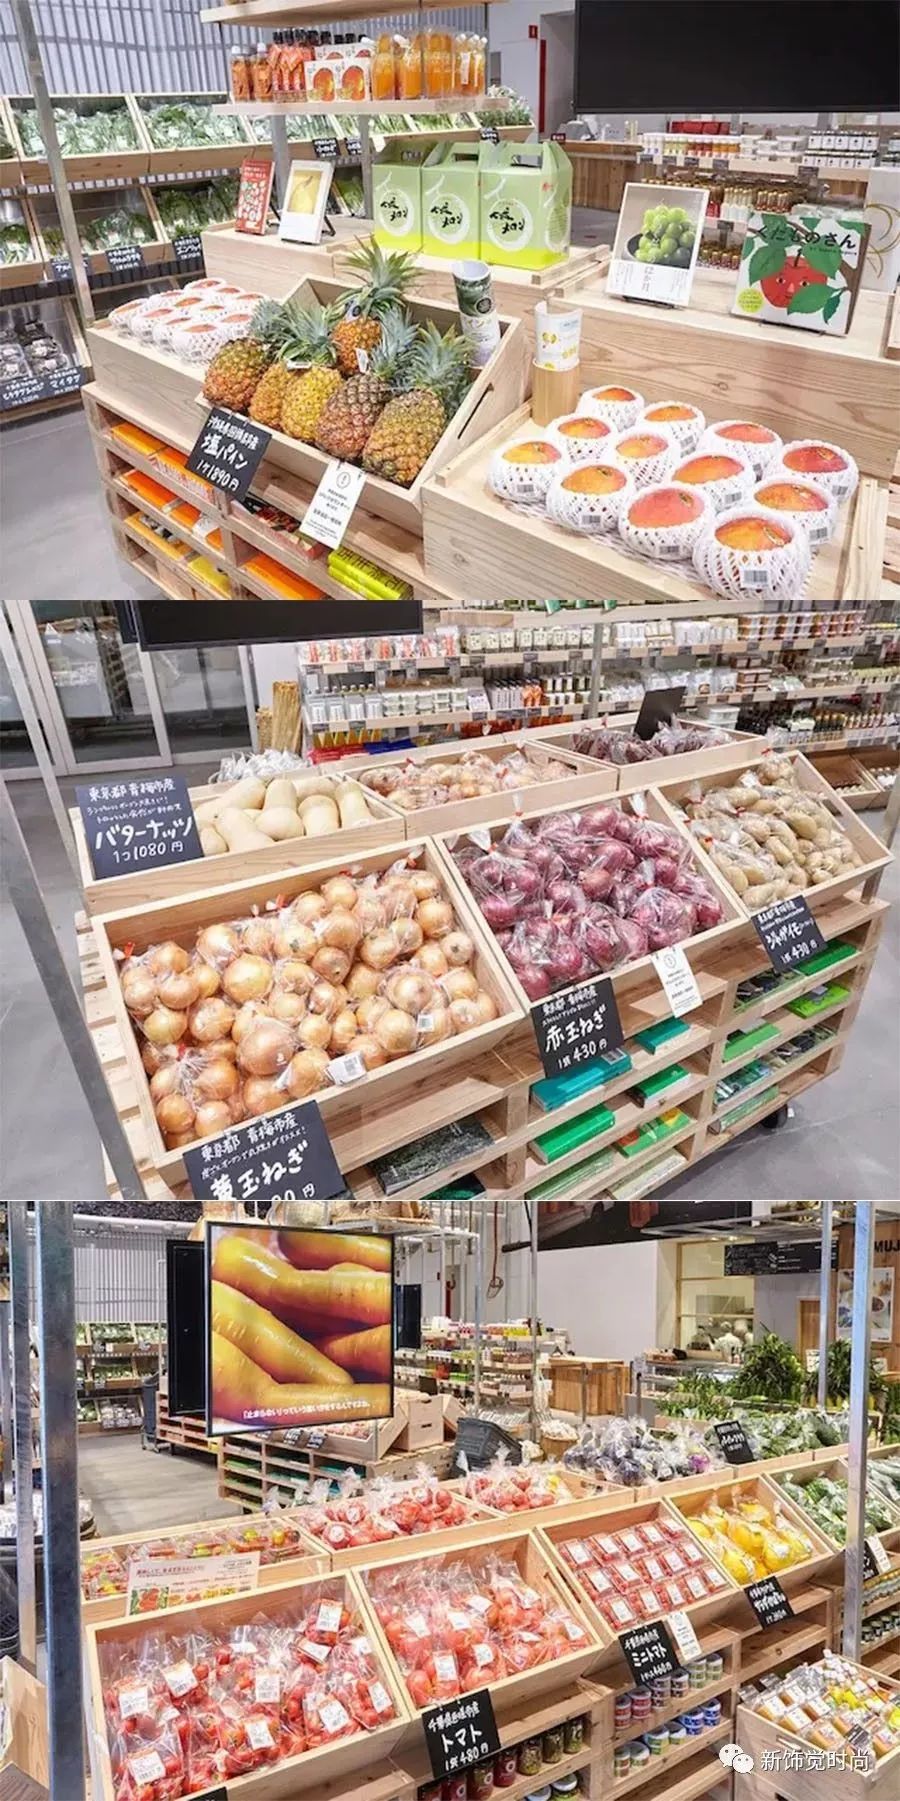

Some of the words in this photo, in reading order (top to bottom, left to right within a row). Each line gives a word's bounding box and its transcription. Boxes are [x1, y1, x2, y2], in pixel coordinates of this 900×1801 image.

[757, 225, 856, 249] くだものさん
[201, 433, 248, 470] 塩パイン
[89, 784, 128, 802] 東京都
[129, 778, 175, 796] 青梅市産
[95, 816, 193, 850] バターナッツ
[545, 1003, 607, 1053] 赤玉ねぎ
[201, 1133, 241, 1162] 東京都
[247, 1112, 299, 1144] 青梅市産
[210, 1140, 308, 1200] 黄玉ねぎ
[631, 1642, 668, 1668] ミニトマト
[441, 1723, 482, 1754] トマト
